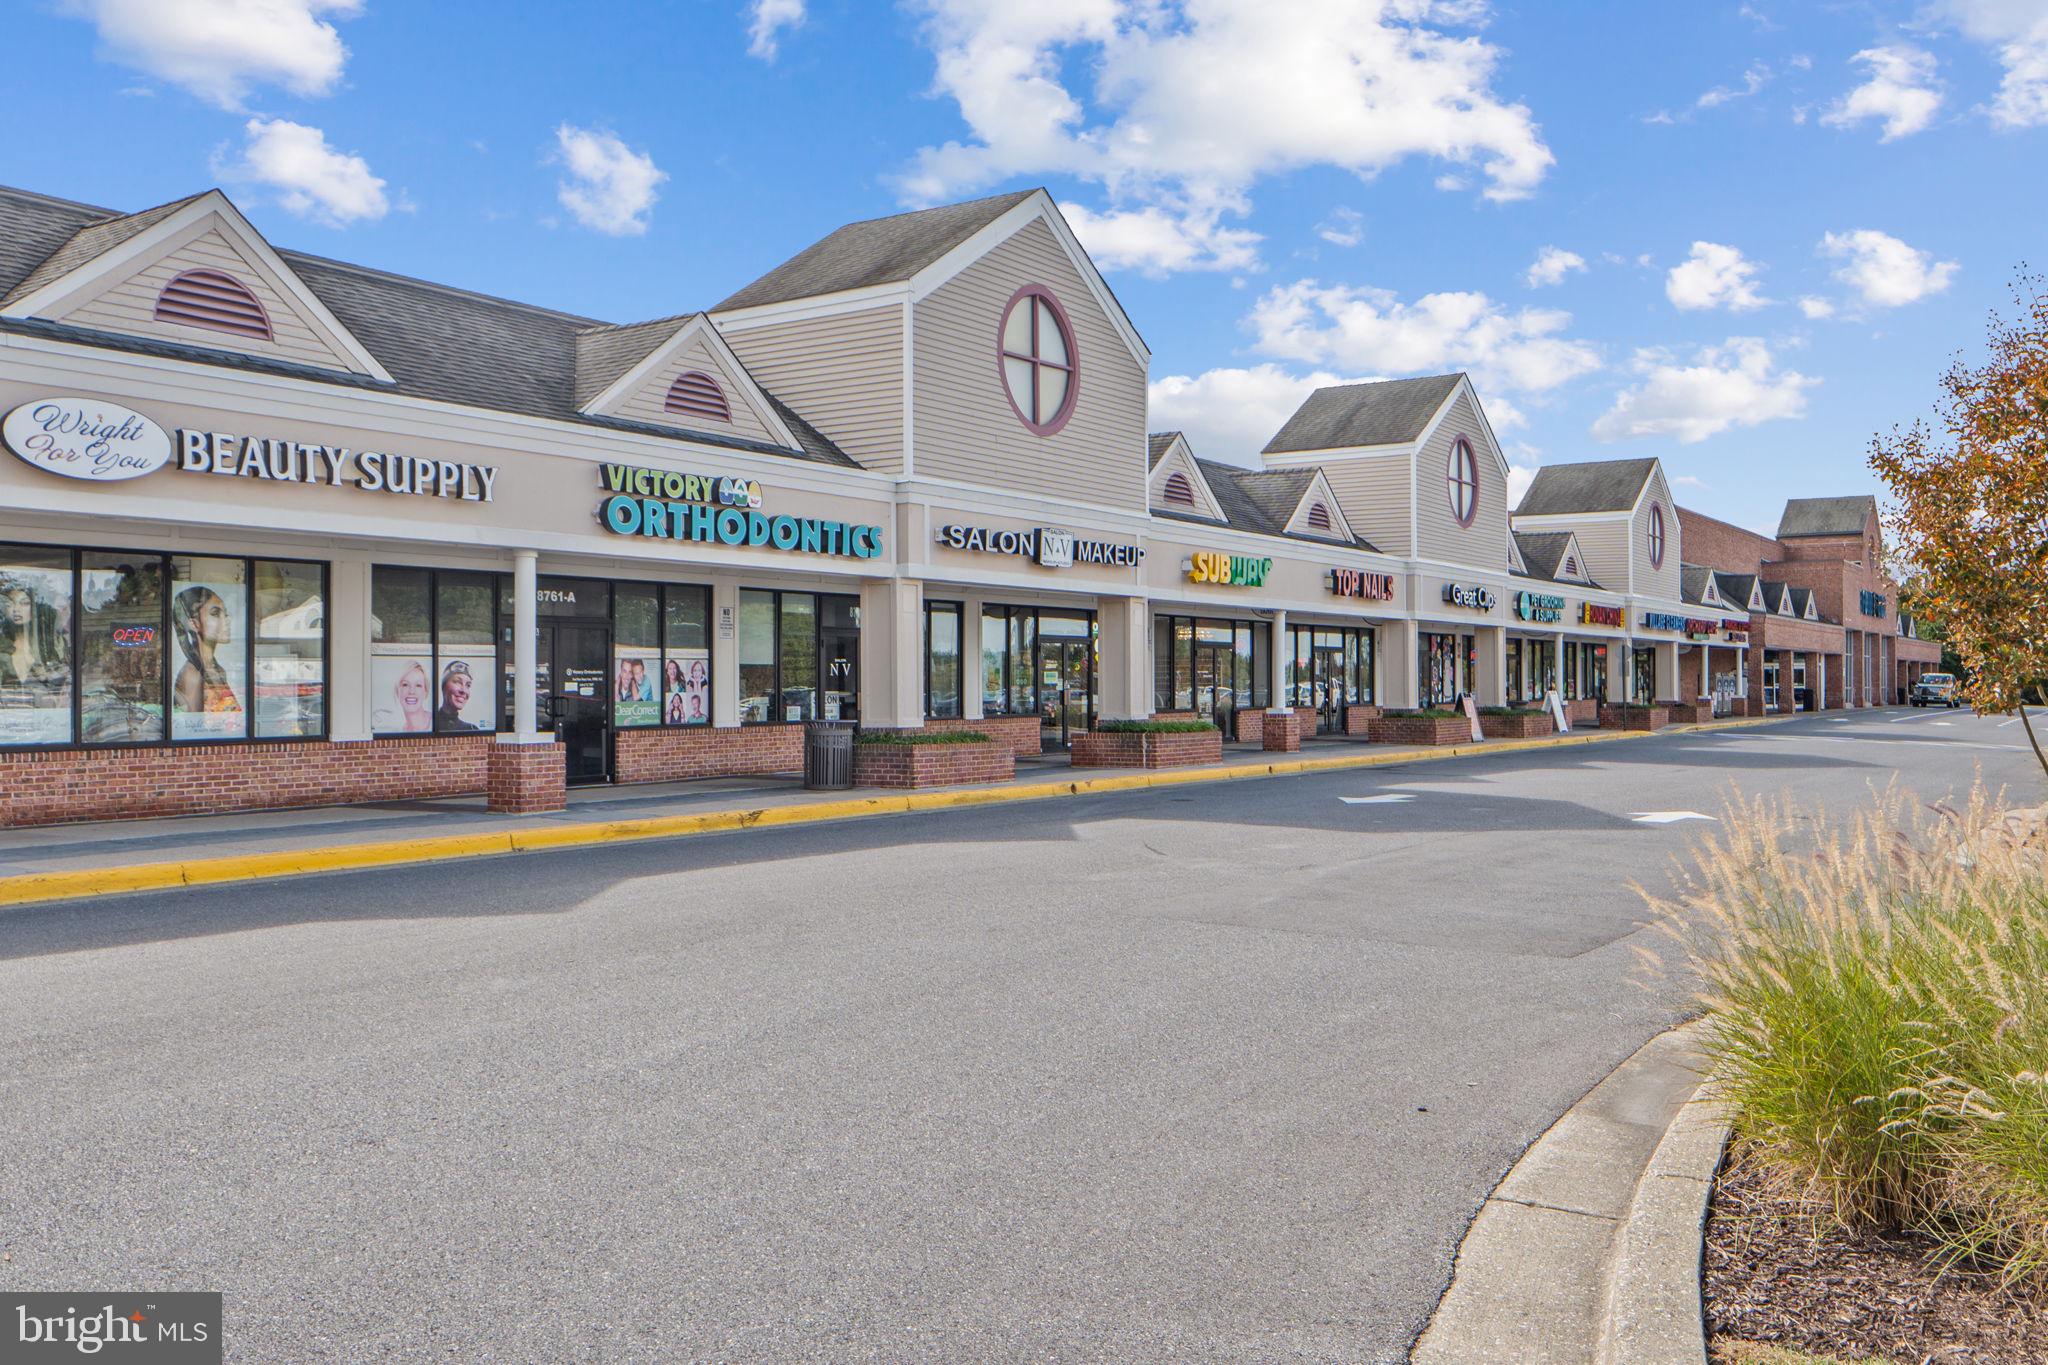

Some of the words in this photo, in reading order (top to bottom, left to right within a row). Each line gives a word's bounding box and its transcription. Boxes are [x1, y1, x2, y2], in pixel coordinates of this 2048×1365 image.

[32, 404, 145, 444] Wright
[25, 433, 80, 461] For
[85, 440, 152, 475] You
[178, 429, 349, 486] BEAUTY
[356, 451, 499, 502] SUPPLY
[602, 463, 715, 503] VICTORY
[601, 495, 884, 559] ORTHODONTICS
[947, 525, 1035, 557] SALON
[1077, 540, 1147, 567] MAKEUP
[1188, 552, 1273, 587] SUBWAY
[536, 590, 576, 603] 8761-A
[1333, 567, 1360, 597] TOP
[1362, 571, 1394, 601] NAILS
[1452, 583, 1477, 607] Great
[1531, 592, 1540, 607] PET
[113, 629, 155, 642] OPEN
